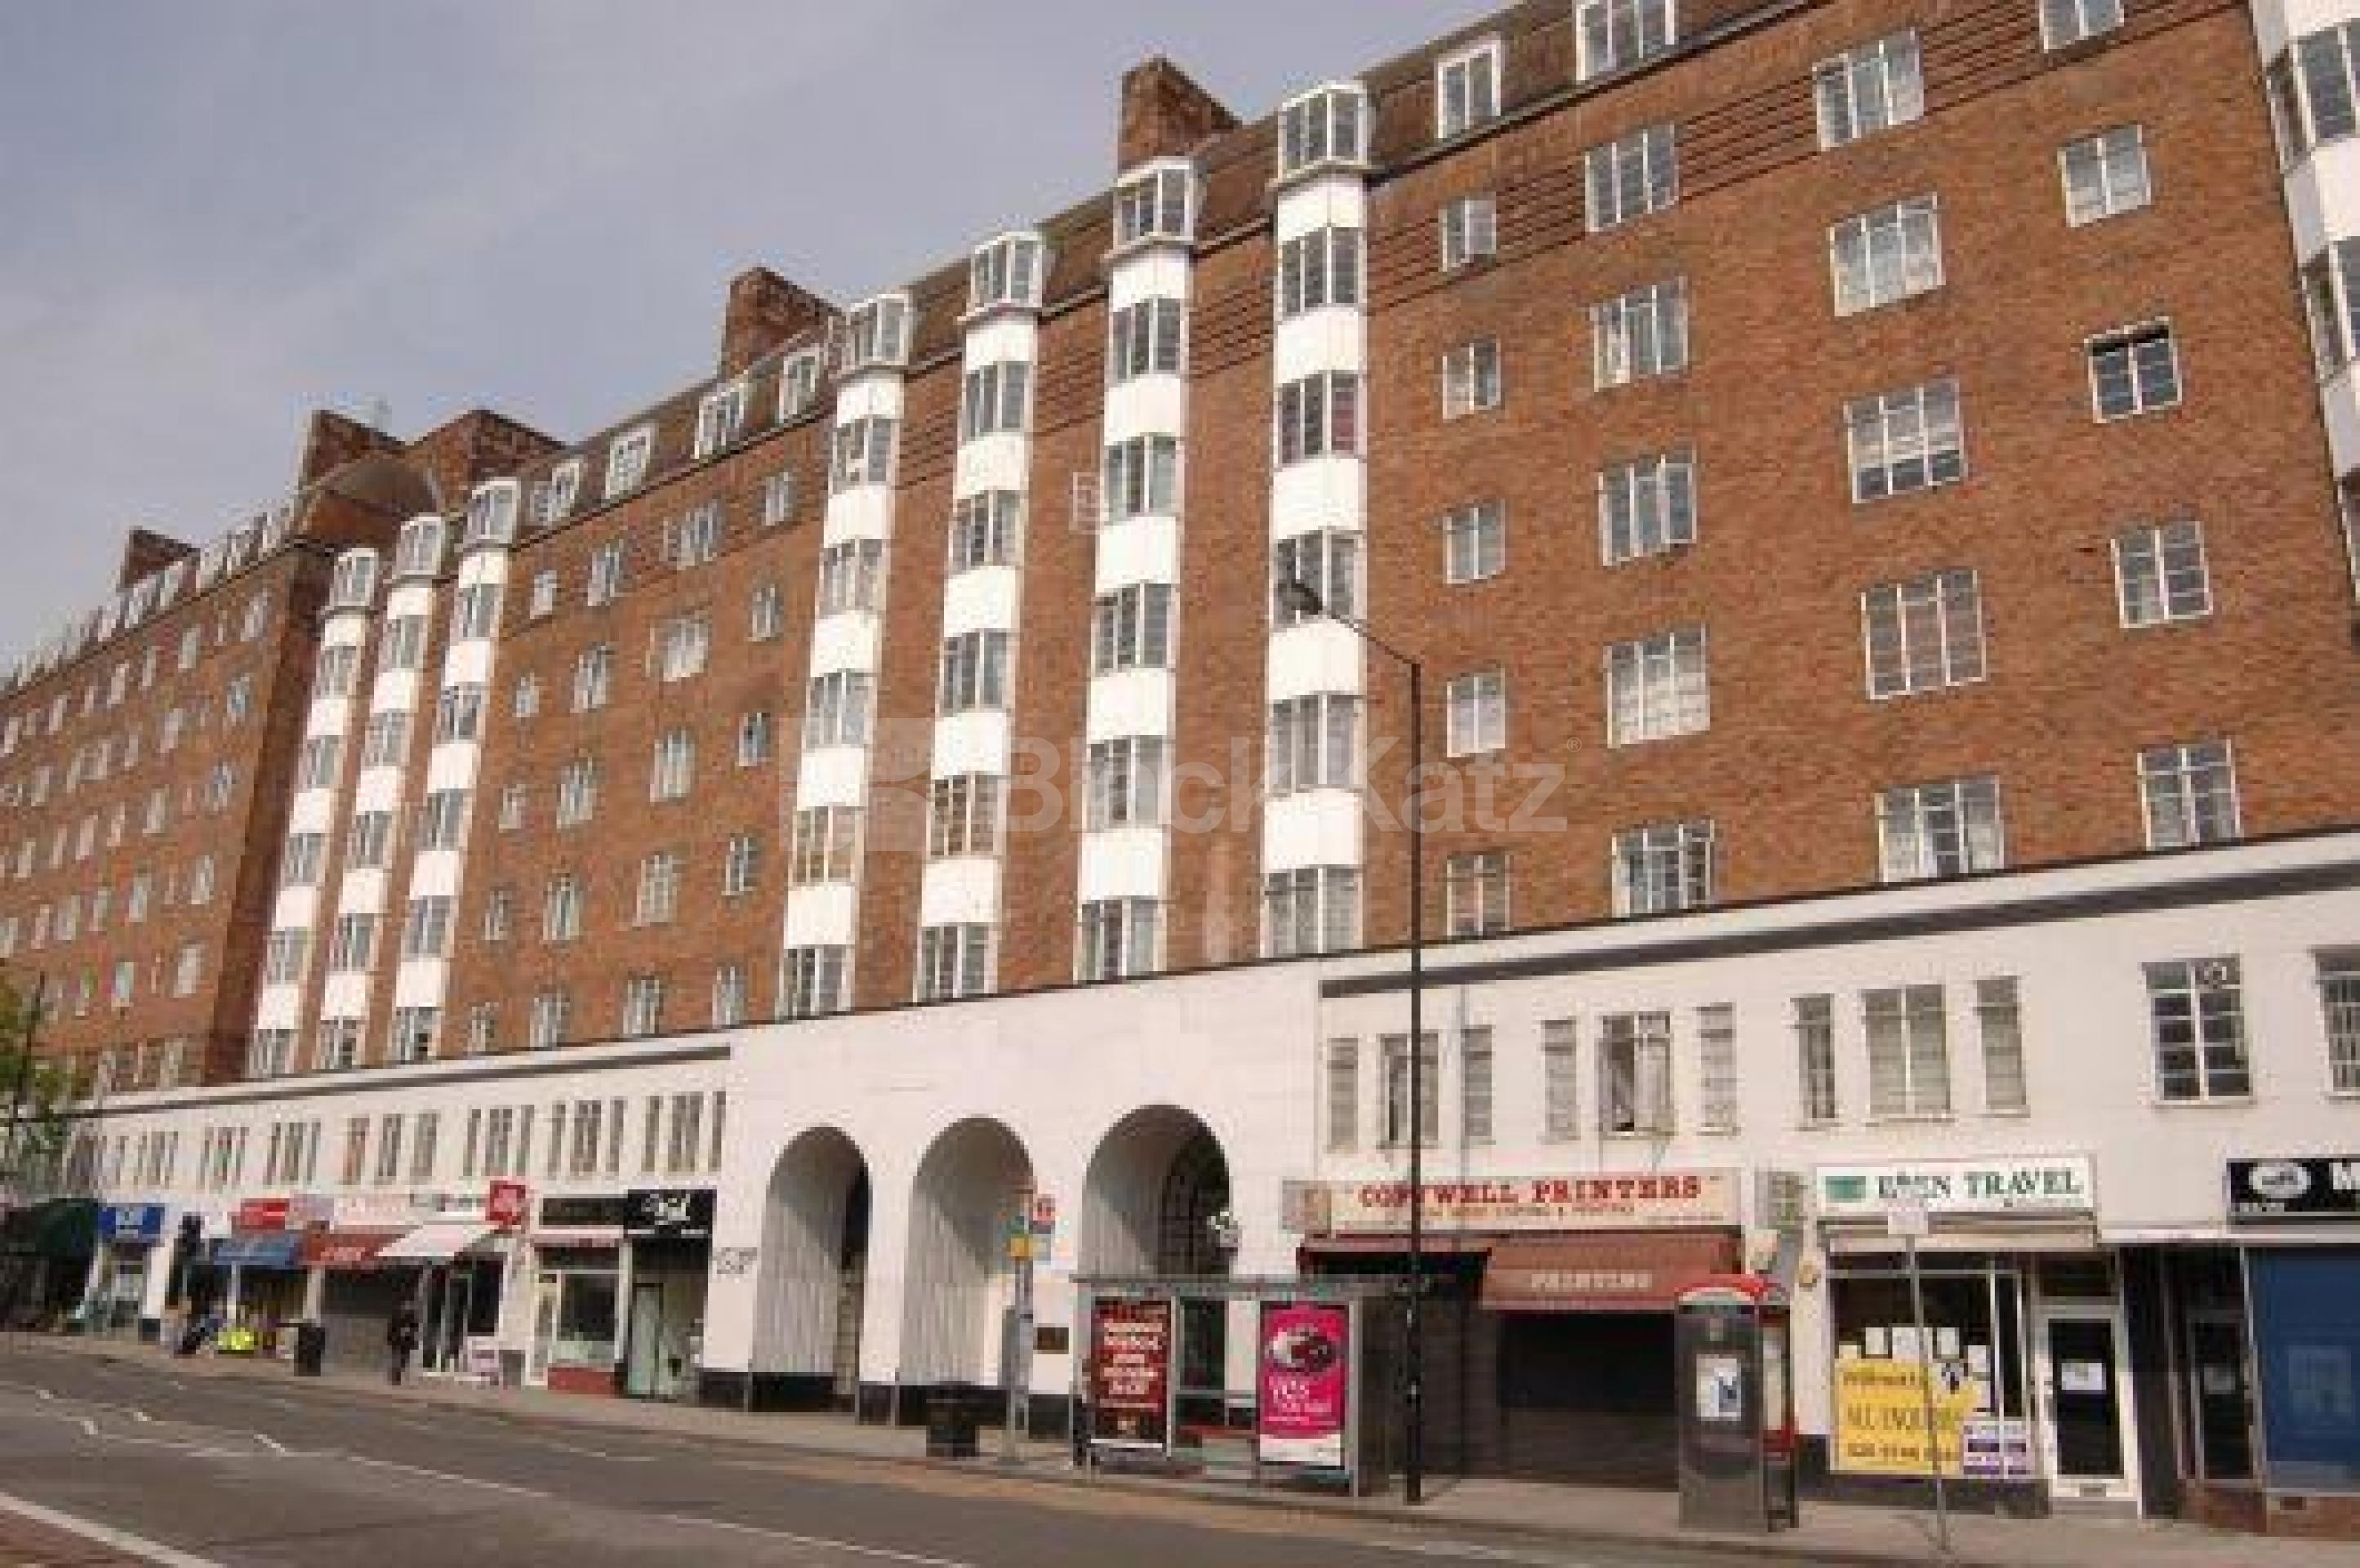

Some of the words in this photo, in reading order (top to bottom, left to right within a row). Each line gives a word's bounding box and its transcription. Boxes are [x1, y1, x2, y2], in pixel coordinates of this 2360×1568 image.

[1358, 1183, 1520, 1208] COPWELL
[1531, 1178, 1702, 1205] PRINTERS
[1963, 1167, 2084, 1196] TRAVEL
